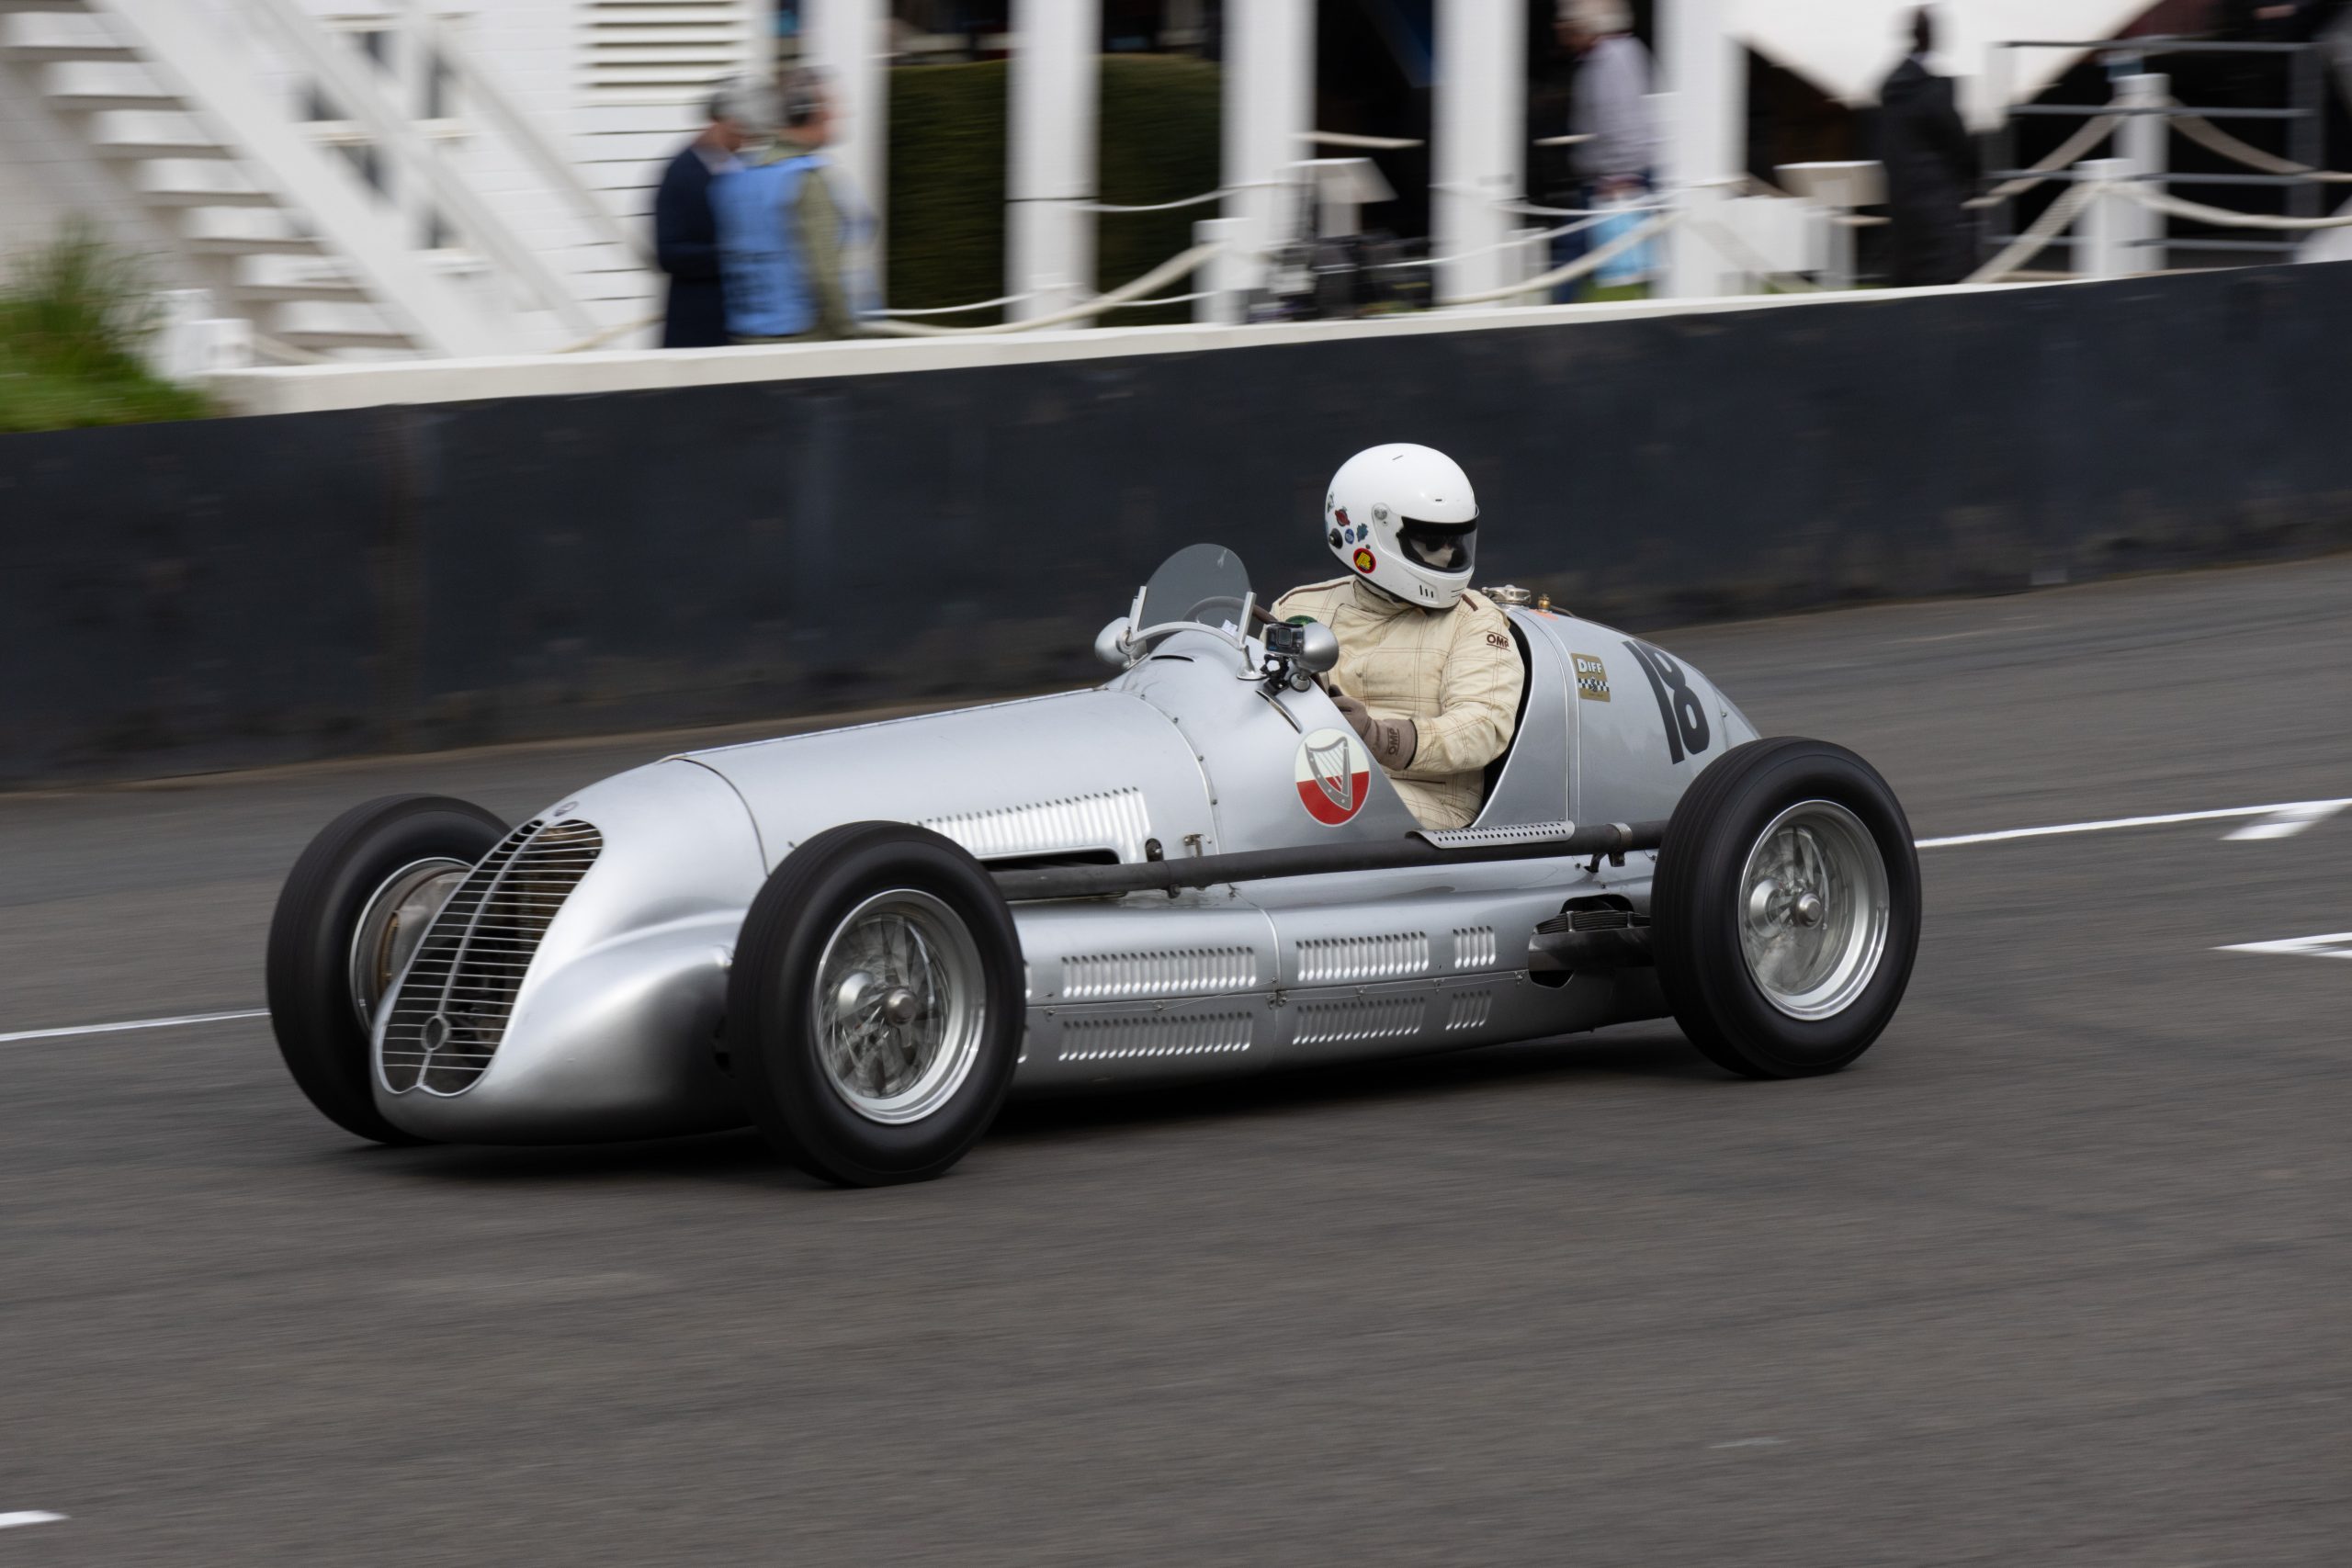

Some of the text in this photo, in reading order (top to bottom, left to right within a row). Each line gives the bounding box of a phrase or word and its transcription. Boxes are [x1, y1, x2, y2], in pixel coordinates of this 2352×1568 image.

[1487, 634, 1510, 648] OMP
[1576, 658, 1602, 673] DIFF
[1623, 640, 1710, 764] 18
[1388, 728, 1398, 755] OMP
